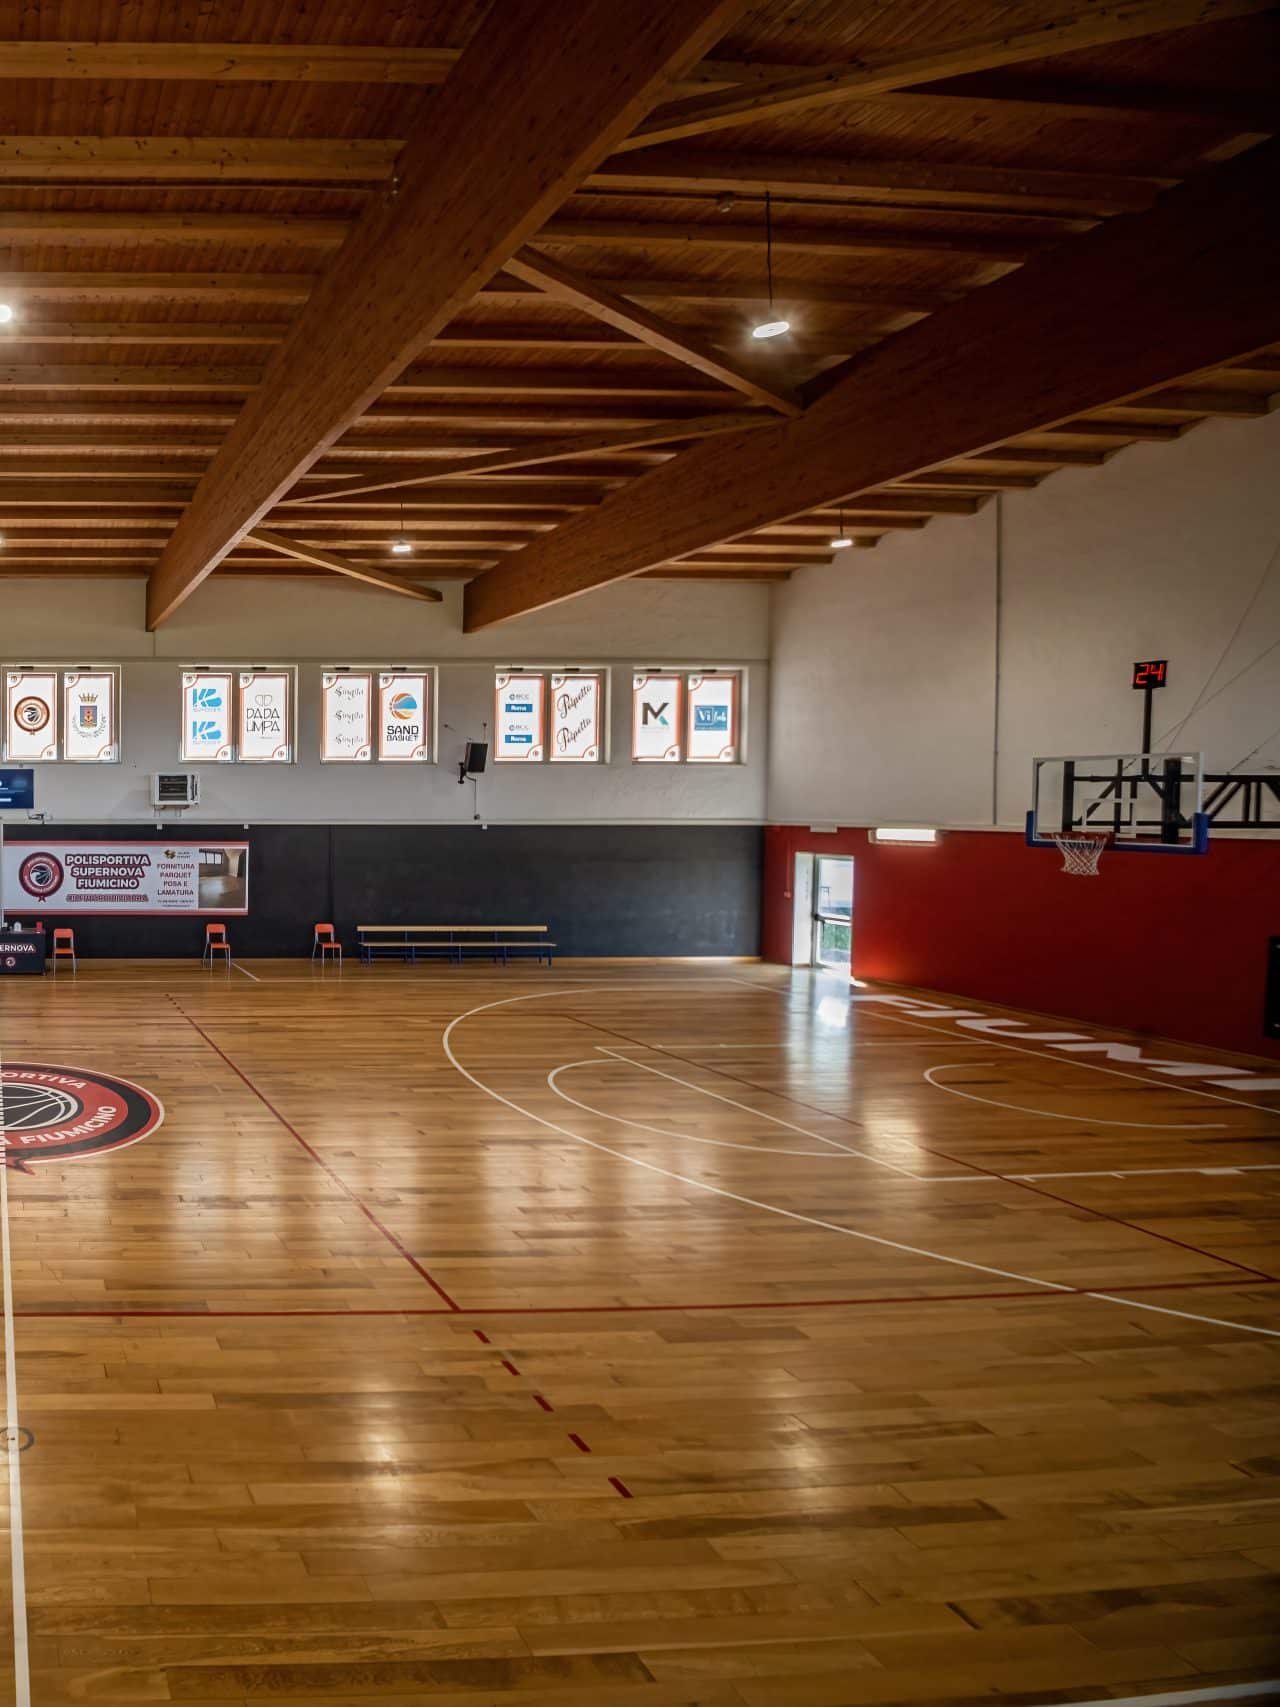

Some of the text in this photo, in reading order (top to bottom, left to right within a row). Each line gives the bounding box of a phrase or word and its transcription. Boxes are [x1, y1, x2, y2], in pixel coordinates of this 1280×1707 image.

[1136, 663, 1164, 684] 24
[246, 708, 280, 719] DADA
[387, 725, 419, 735] SAND
[66, 855, 150, 865] POLISPORTIVA
[72, 867, 143, 876] SUPERNOVA
[77, 879, 138, 888] FIUMICINO
[20, 1104, 117, 1145] FIUMICINO
